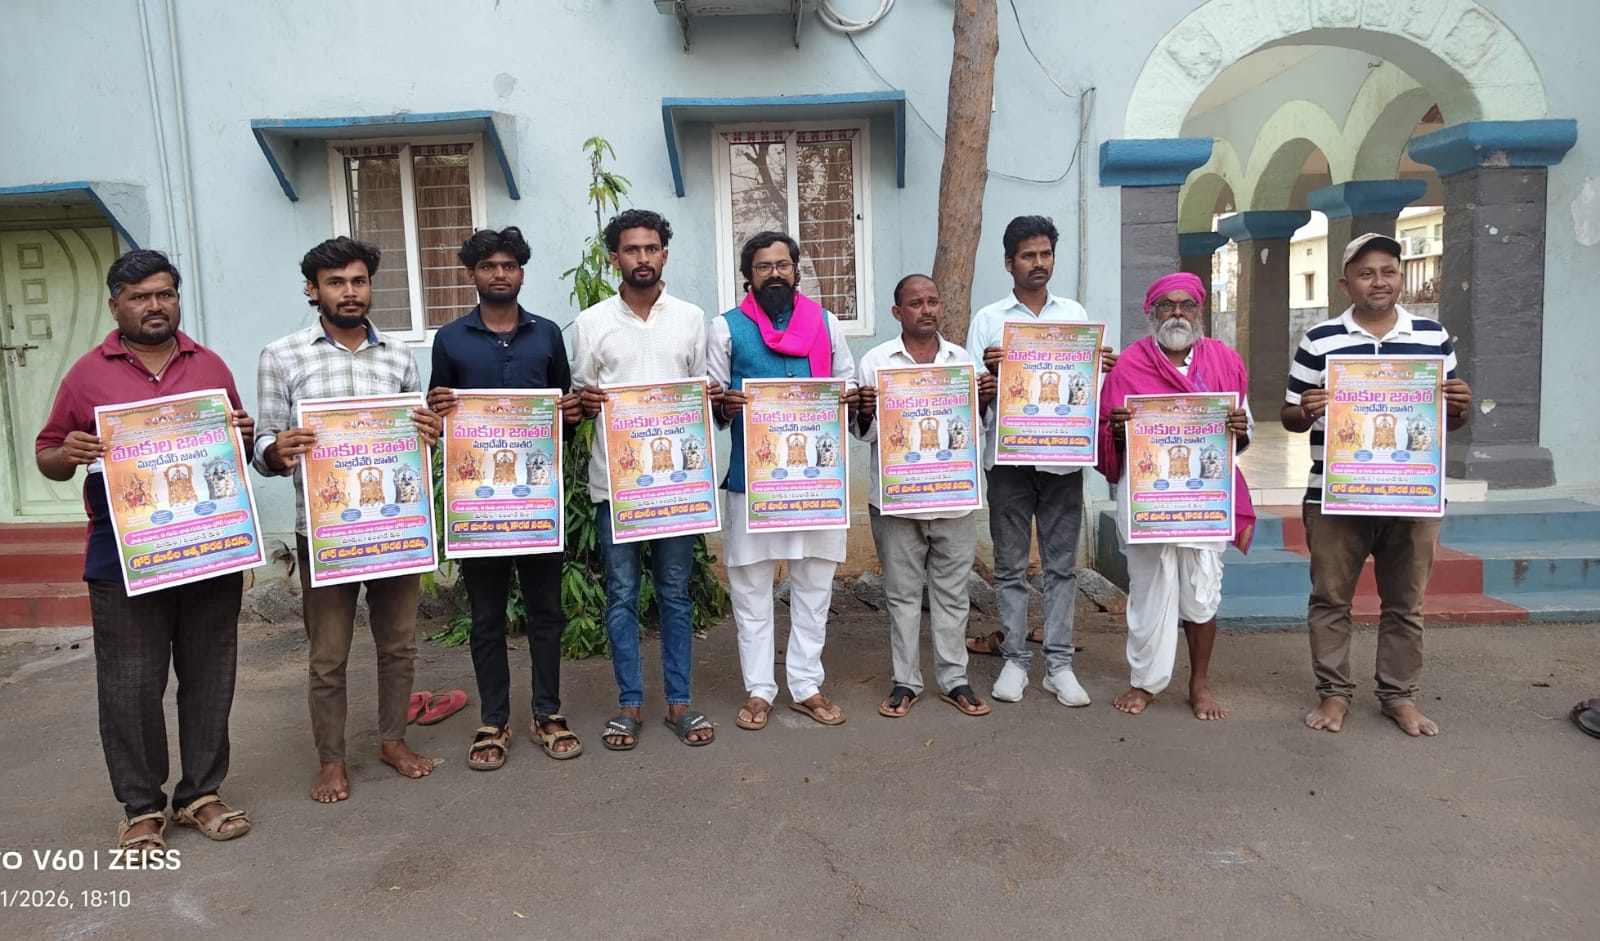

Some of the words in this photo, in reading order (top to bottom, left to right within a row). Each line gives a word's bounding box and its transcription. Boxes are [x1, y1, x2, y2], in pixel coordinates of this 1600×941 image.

[1008, 349, 1051, 361] మాకుల
[1054, 350, 1091, 361] జాతర
[885, 397, 928, 409] మాకుల
[931, 394, 967, 406] జాతర
[1335, 389, 1385, 402] మాకుల
[1389, 388, 1433, 402] జాతర
[612, 415, 659, 431] మాకుల
[662, 411, 701, 425] జాతర
[752, 412, 796, 424] మాకుల
[799, 410, 836, 421] జాతర
[454, 424, 504, 438] మాకుల
[508, 424, 551, 437] జాతర
[663, 426, 685, 435] జాతర
[1135, 423, 1179, 436] మాకుల
[1183, 421, 1223, 434] జాతర
[112, 439, 173, 462] మాకుల
[176, 429, 226, 449] జాతర
[313, 442, 368, 459] మాకుల
[372, 438, 416, 453] జాతర
[508, 439, 532, 448] జాతర
[179, 448, 207, 461] జాతర
[373, 454, 398, 465] జాతర
